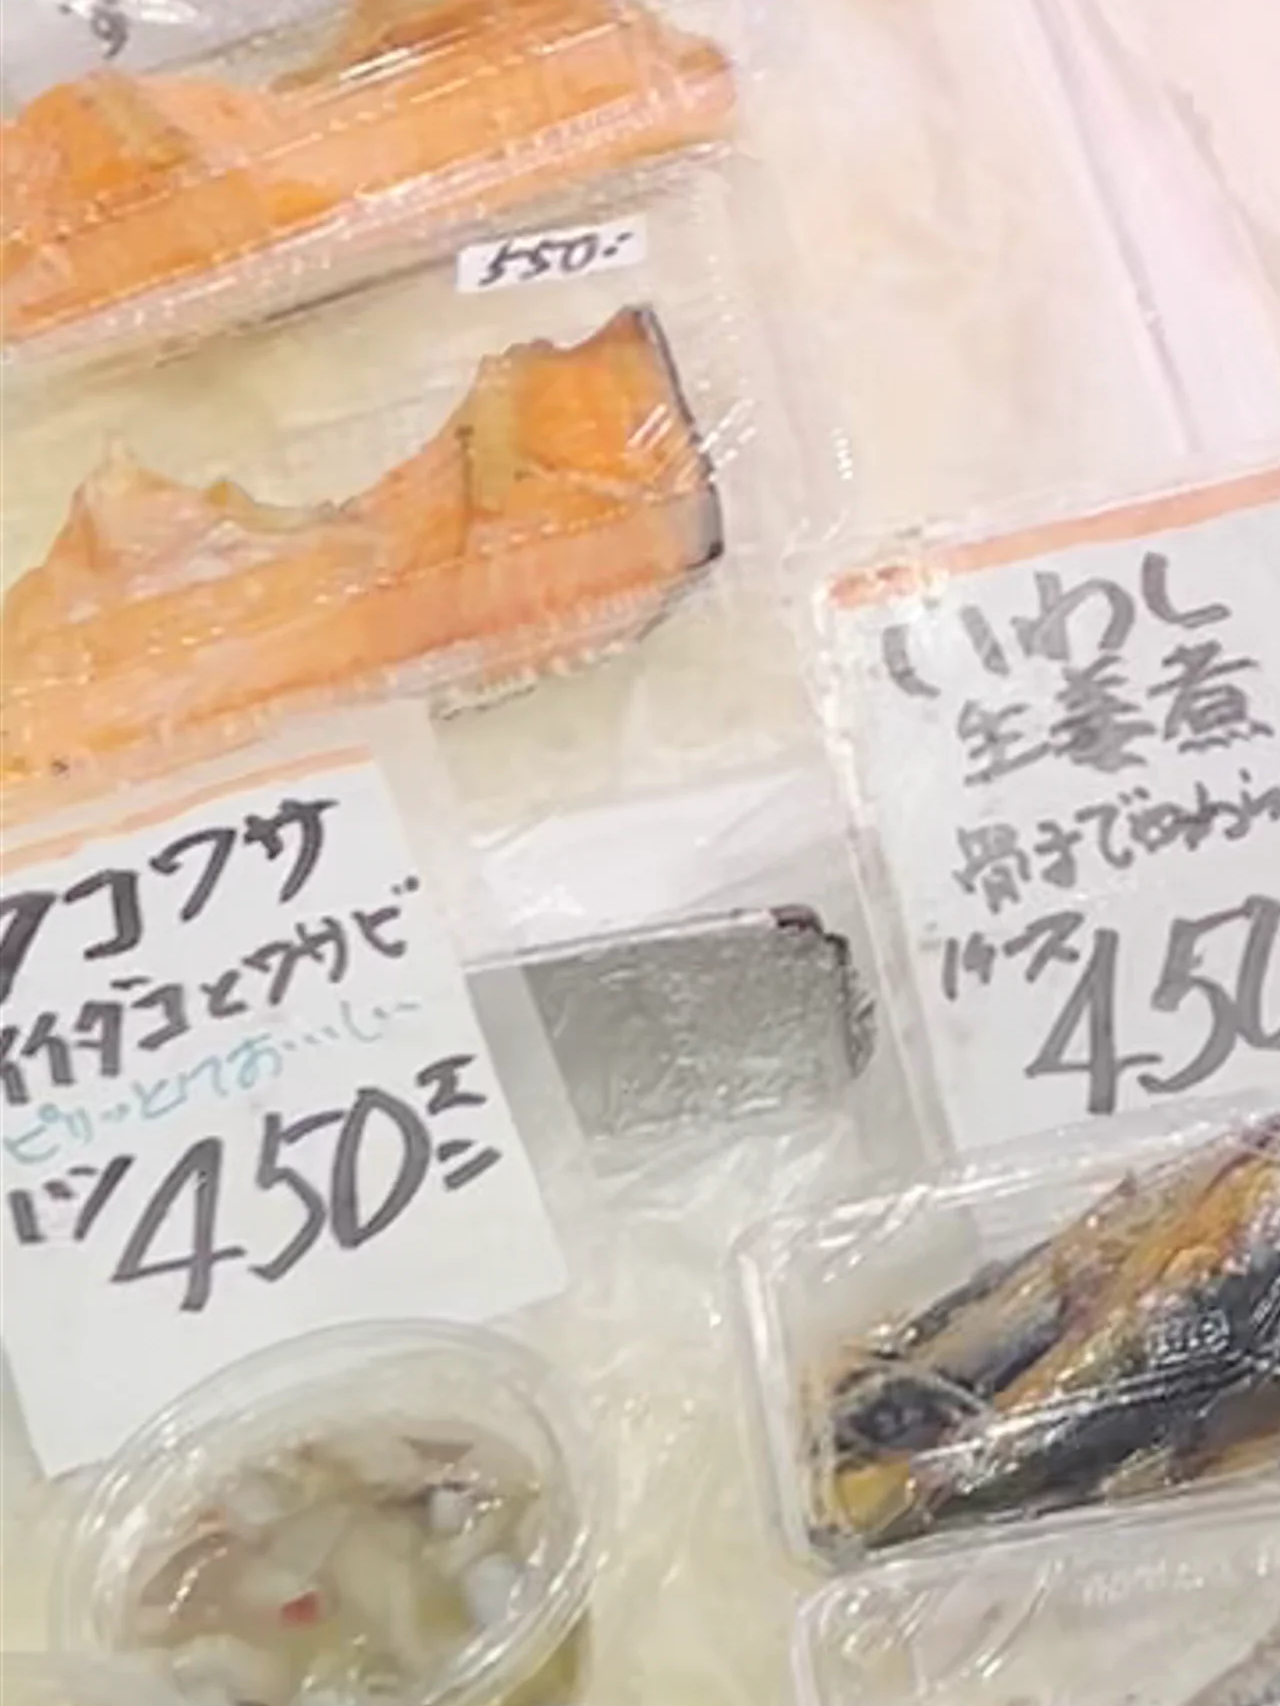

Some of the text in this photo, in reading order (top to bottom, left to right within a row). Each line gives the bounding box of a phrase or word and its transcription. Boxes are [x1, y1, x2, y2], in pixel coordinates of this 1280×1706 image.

[884, 551, 1232, 699] いわし
[956, 640, 1275, 787] 生姜煮
